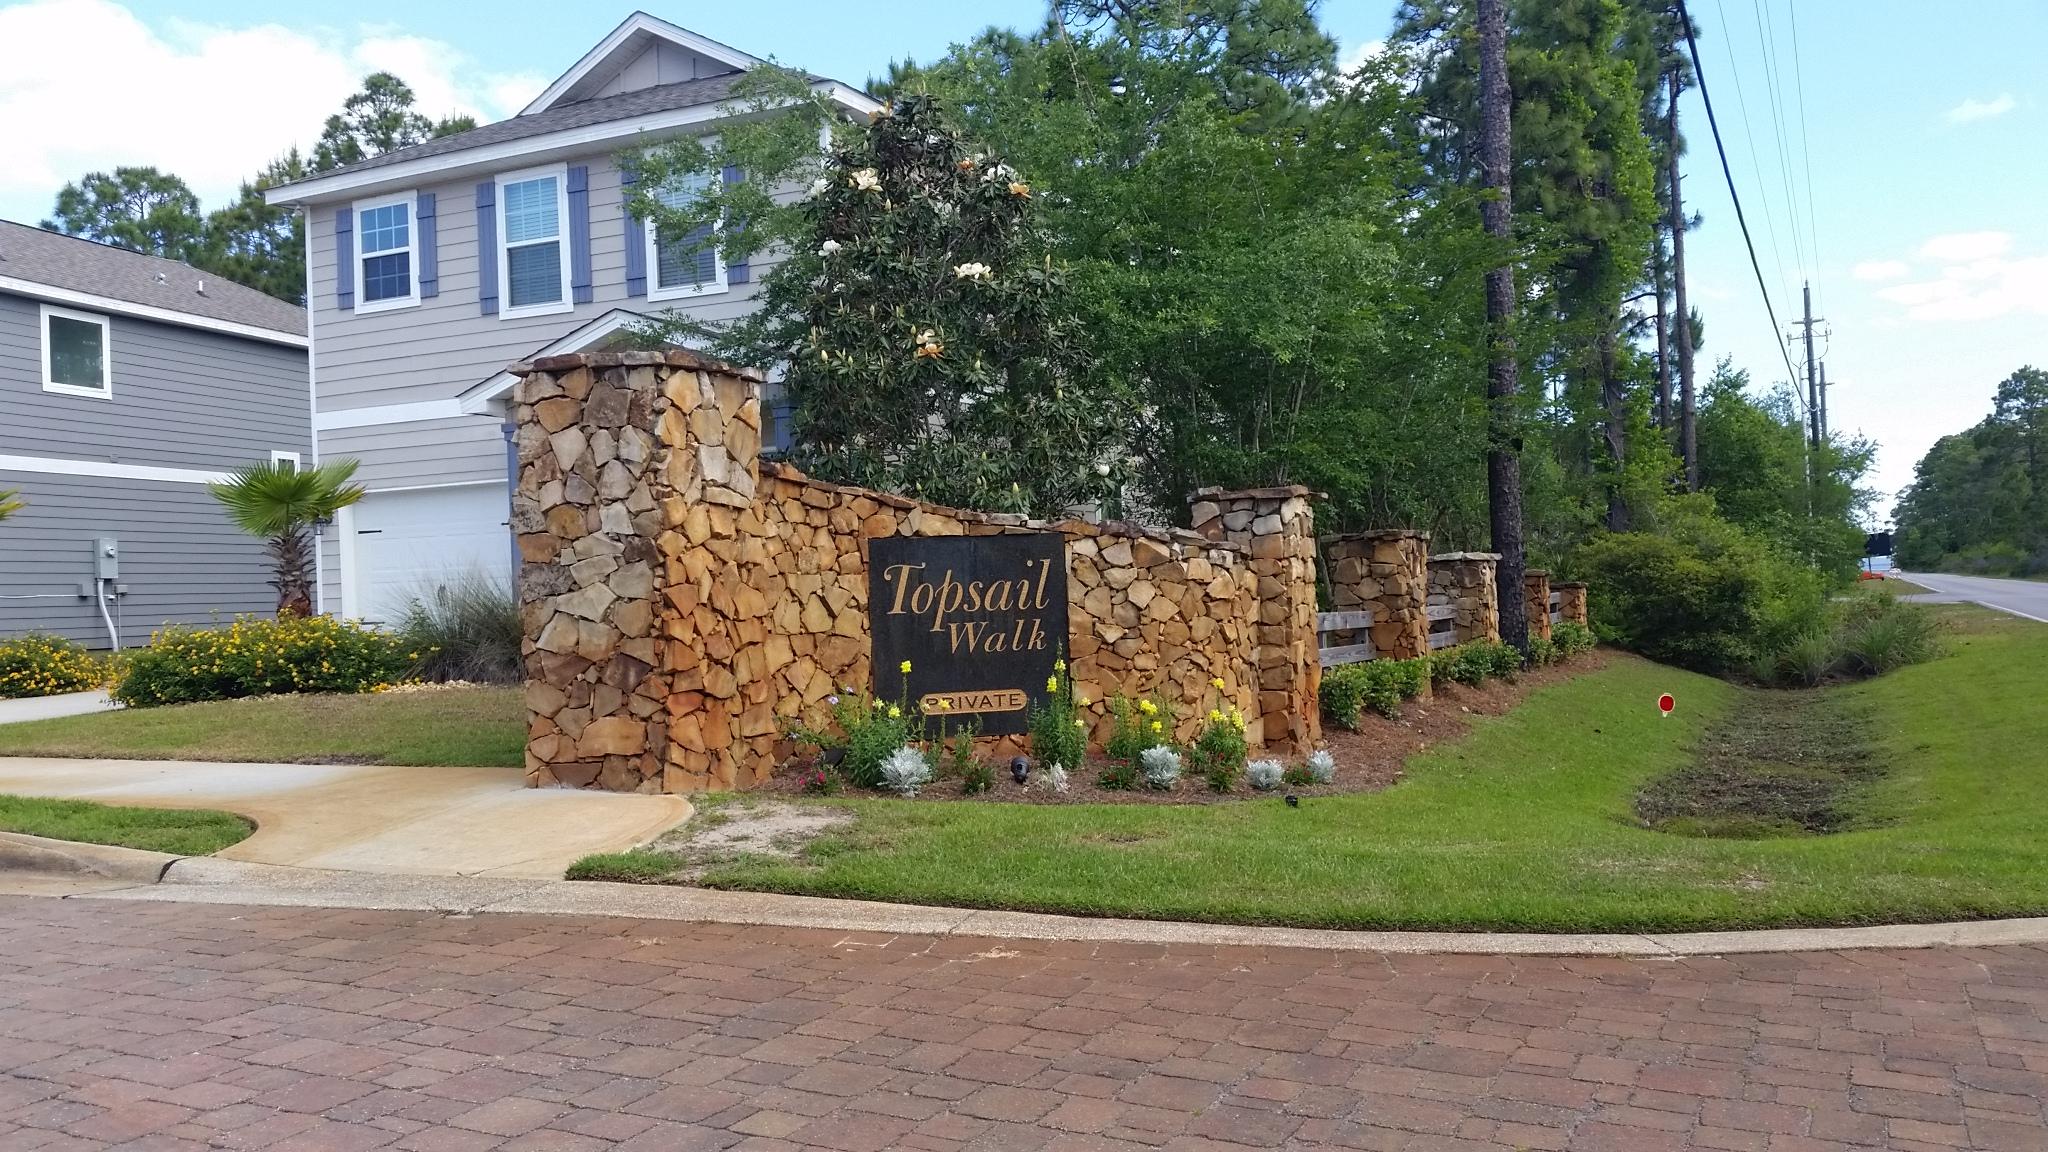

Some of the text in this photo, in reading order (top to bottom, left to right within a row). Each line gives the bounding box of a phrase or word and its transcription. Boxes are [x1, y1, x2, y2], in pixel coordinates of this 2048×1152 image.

[883, 559, 1050, 632] Topsail
[948, 618, 1047, 654] Walk
[925, 693, 1021, 710] PRIVATE
